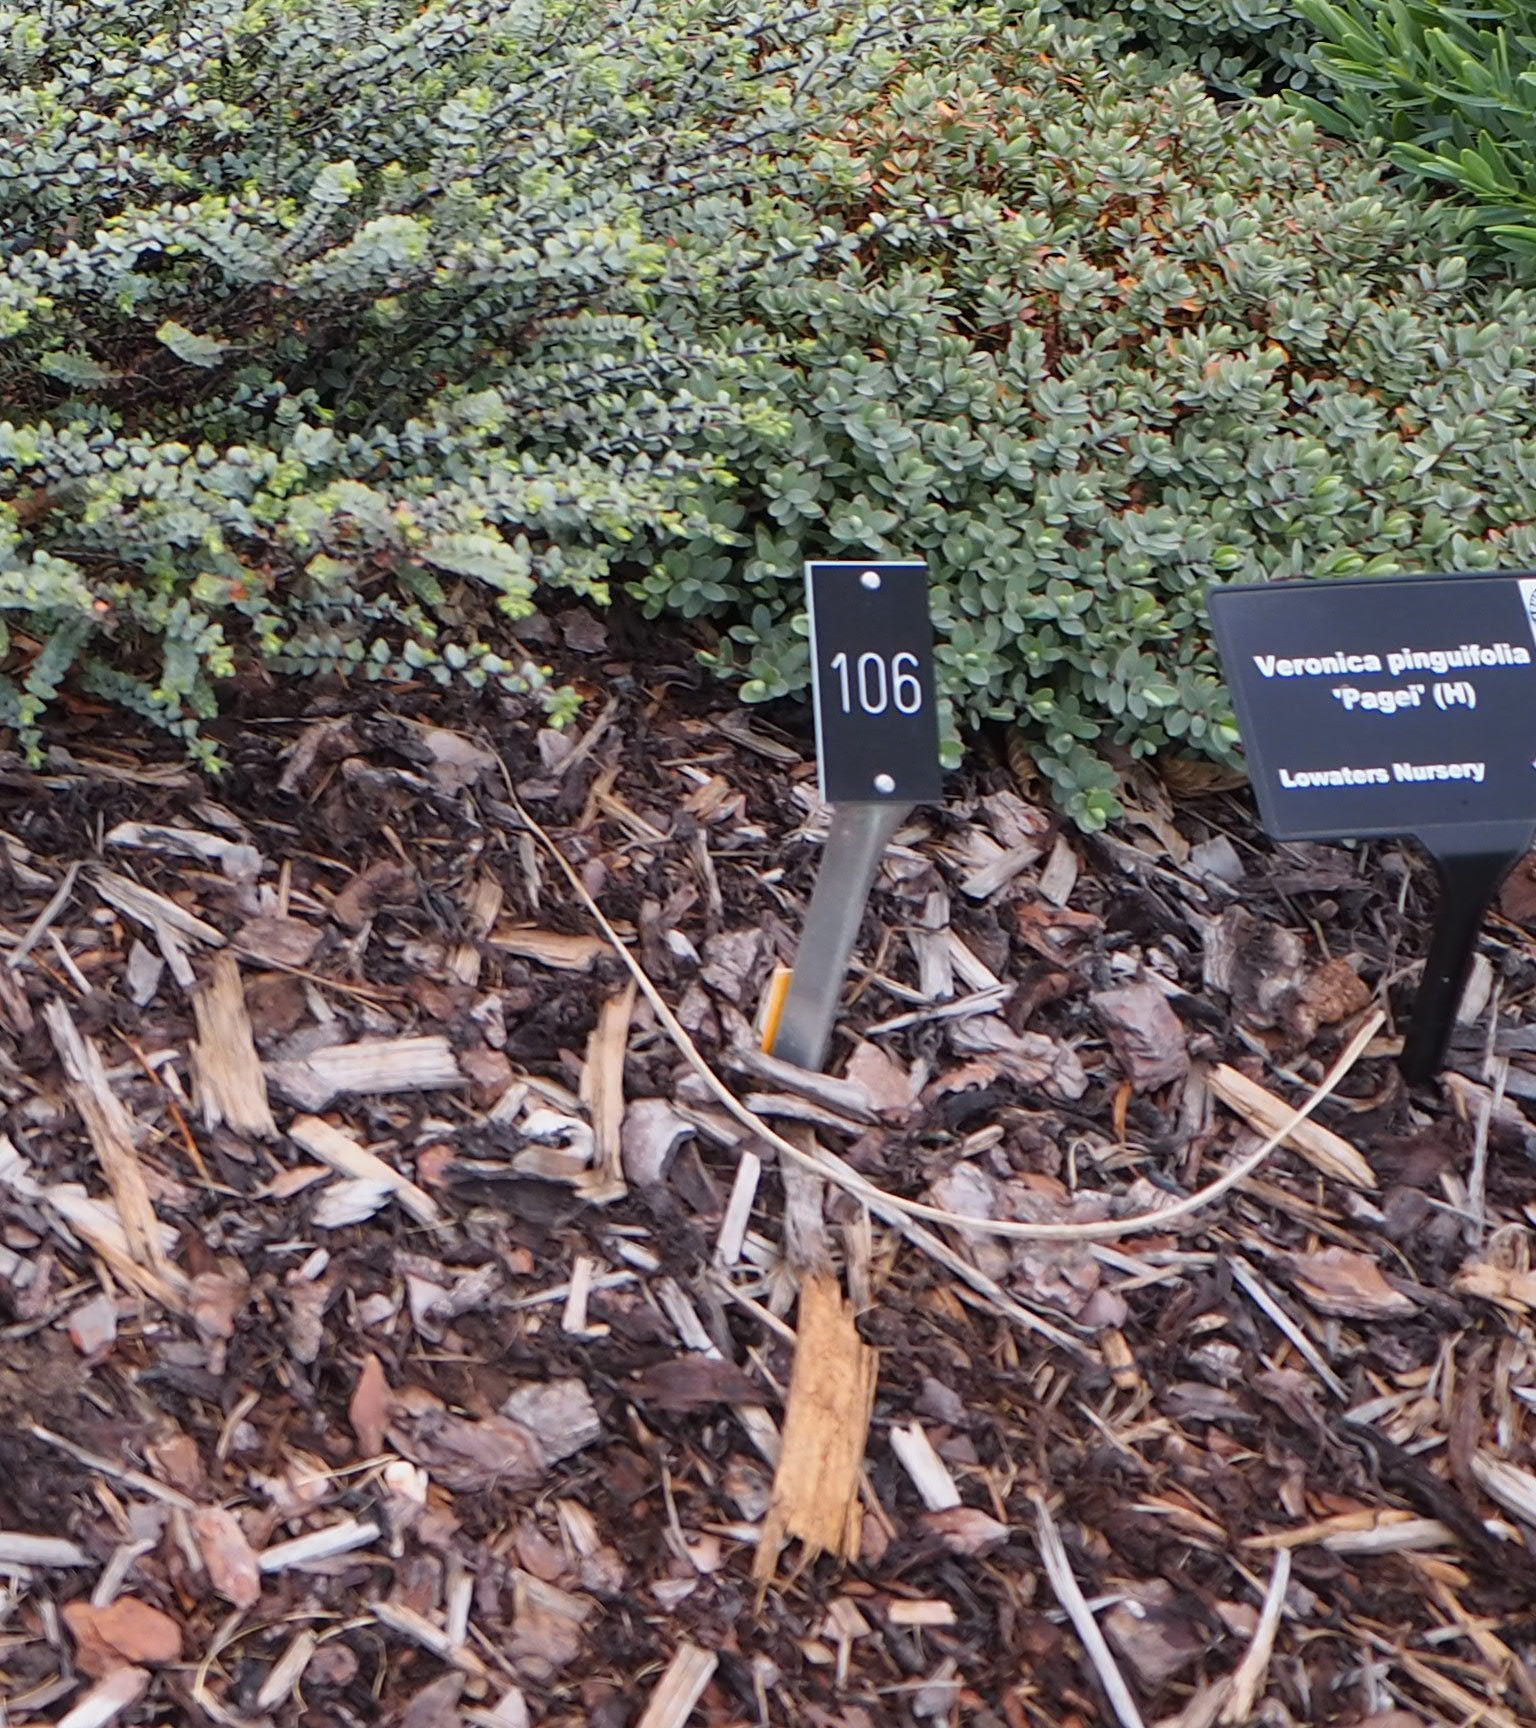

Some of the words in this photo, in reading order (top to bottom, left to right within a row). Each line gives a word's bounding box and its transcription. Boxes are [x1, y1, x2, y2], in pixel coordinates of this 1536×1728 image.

[1253, 651, 1382, 677] Veronica
[1386, 643, 1531, 676] pinguifolia
[831, 652, 922, 714] 106
[1332, 684, 1425, 714] 'Pagei'
[1433, 681, 1476, 710] (H)
[1278, 766, 1390, 788] Lowaters
[1391, 762, 1485, 782] Nursery
